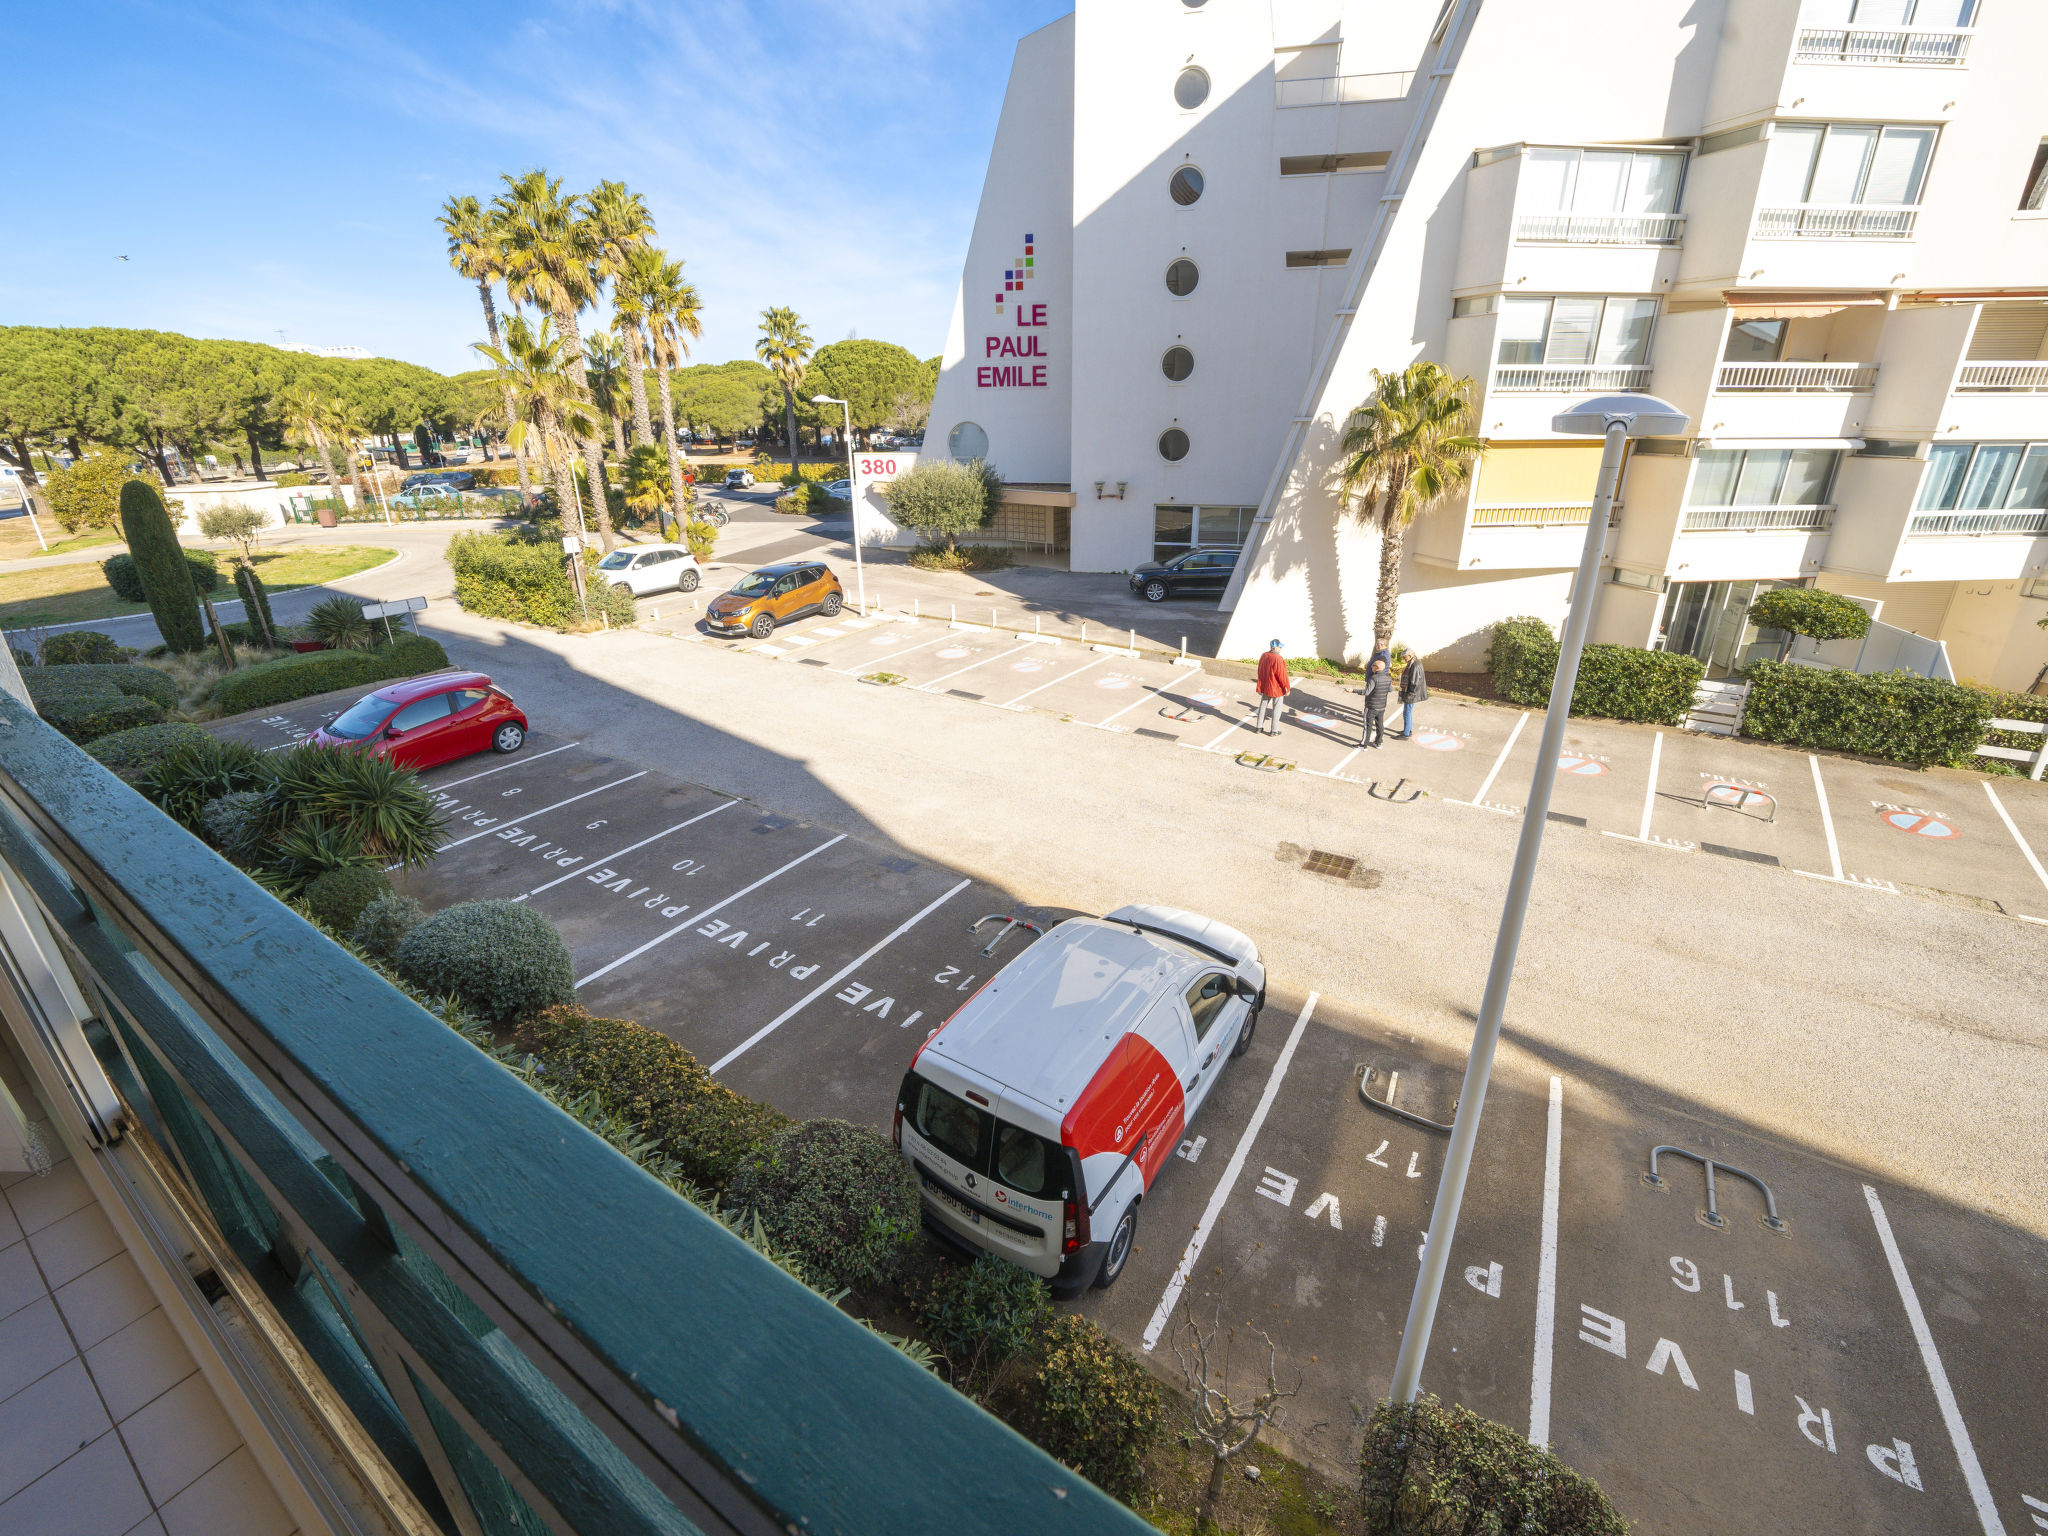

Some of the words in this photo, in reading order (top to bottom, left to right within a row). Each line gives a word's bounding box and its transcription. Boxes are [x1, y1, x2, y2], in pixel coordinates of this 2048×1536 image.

[1017, 304, 1047, 326] LE
[986, 336, 1047, 358] PAUL
[977, 366, 1047, 388] EMILE
[861, 459, 897, 474] 380
[1418, 725, 1473, 739] PRIVE
[1562, 750, 1611, 762] RIVE
[1700, 772, 1769, 789] PRIVE
[502, 788, 522, 797] 8
[1870, 800, 1951, 820] PRIVE
[586, 819, 608, 830] 9
[496, 826, 584, 868] PRIVE
[672, 859, 705, 876] 10
[586, 868, 690, 918] PRIVE
[790, 907, 825, 927] 11
[696, 919, 821, 980] PRIVE
[934, 965, 976, 991] 12
[1255, 1166, 1504, 1299] PIVE
[1669, 1256, 1790, 1328] 116
[1579, 1303, 1924, 1492] PRIVE
